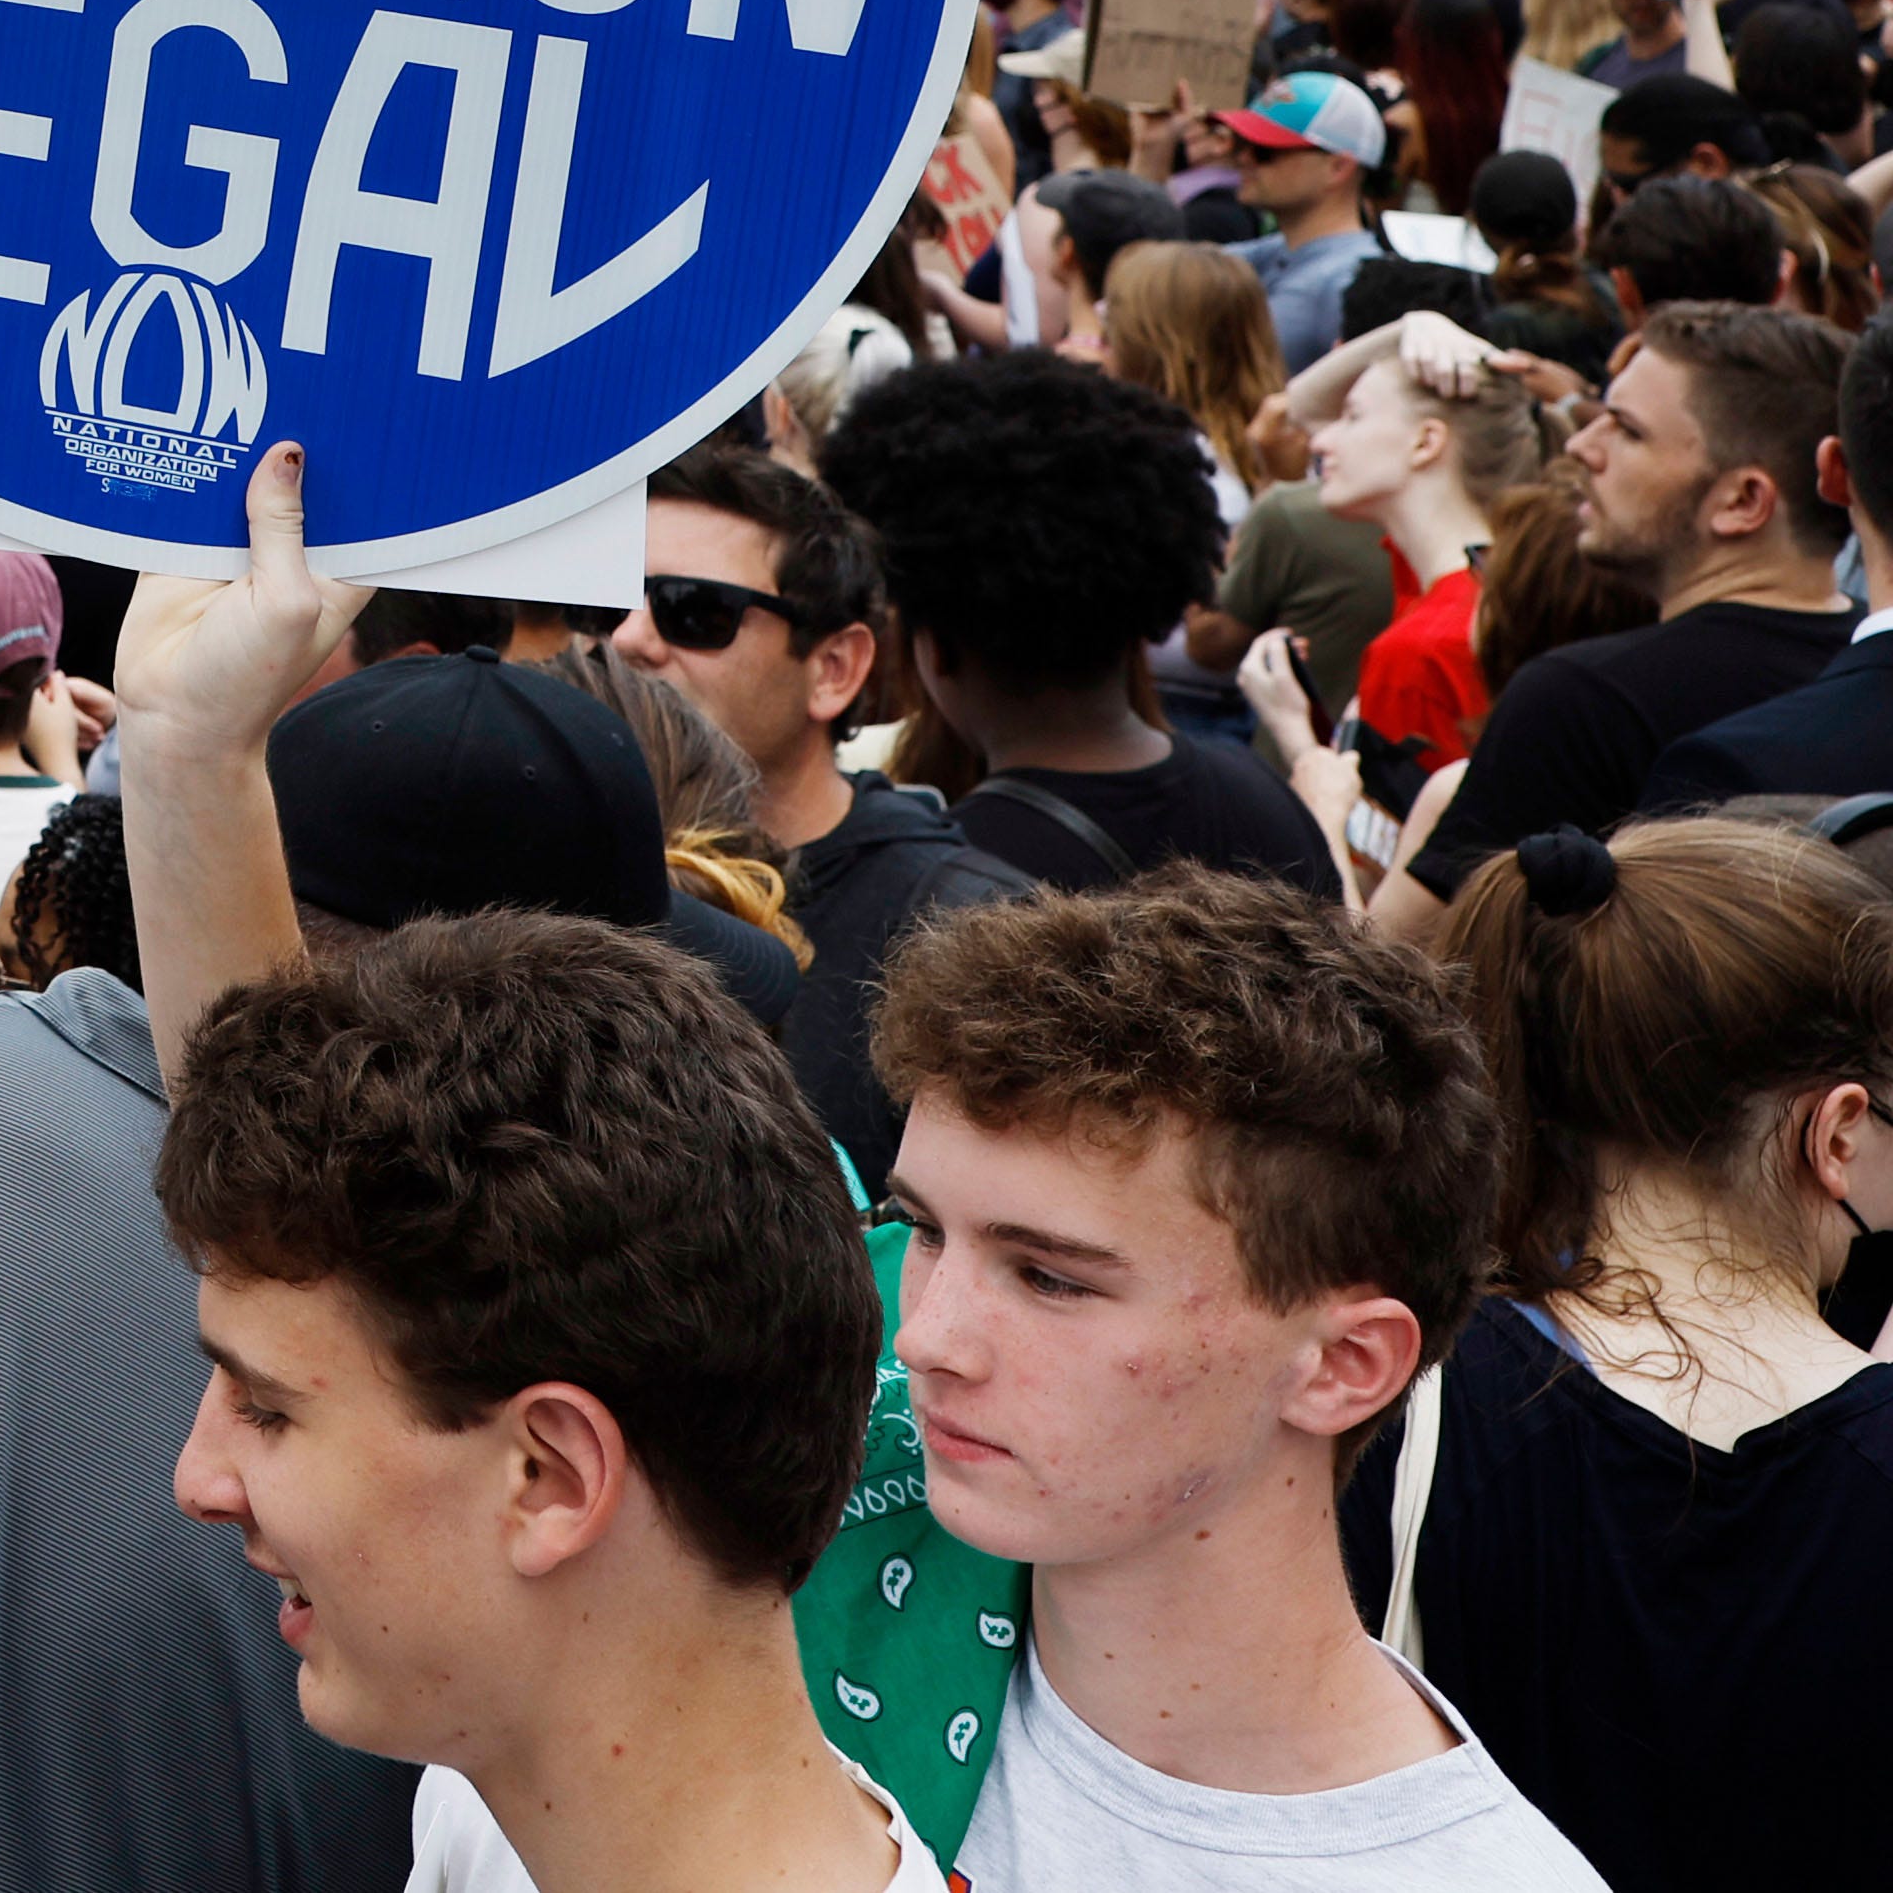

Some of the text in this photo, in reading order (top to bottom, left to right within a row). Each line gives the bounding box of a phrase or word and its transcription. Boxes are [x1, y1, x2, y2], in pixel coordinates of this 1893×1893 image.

[39, 273, 268, 445] NOW
[52, 416, 237, 464] NATIONAL
[64, 438, 219, 479] ORGANIZATION
[86, 458, 196, 489] FOR WOMEN
